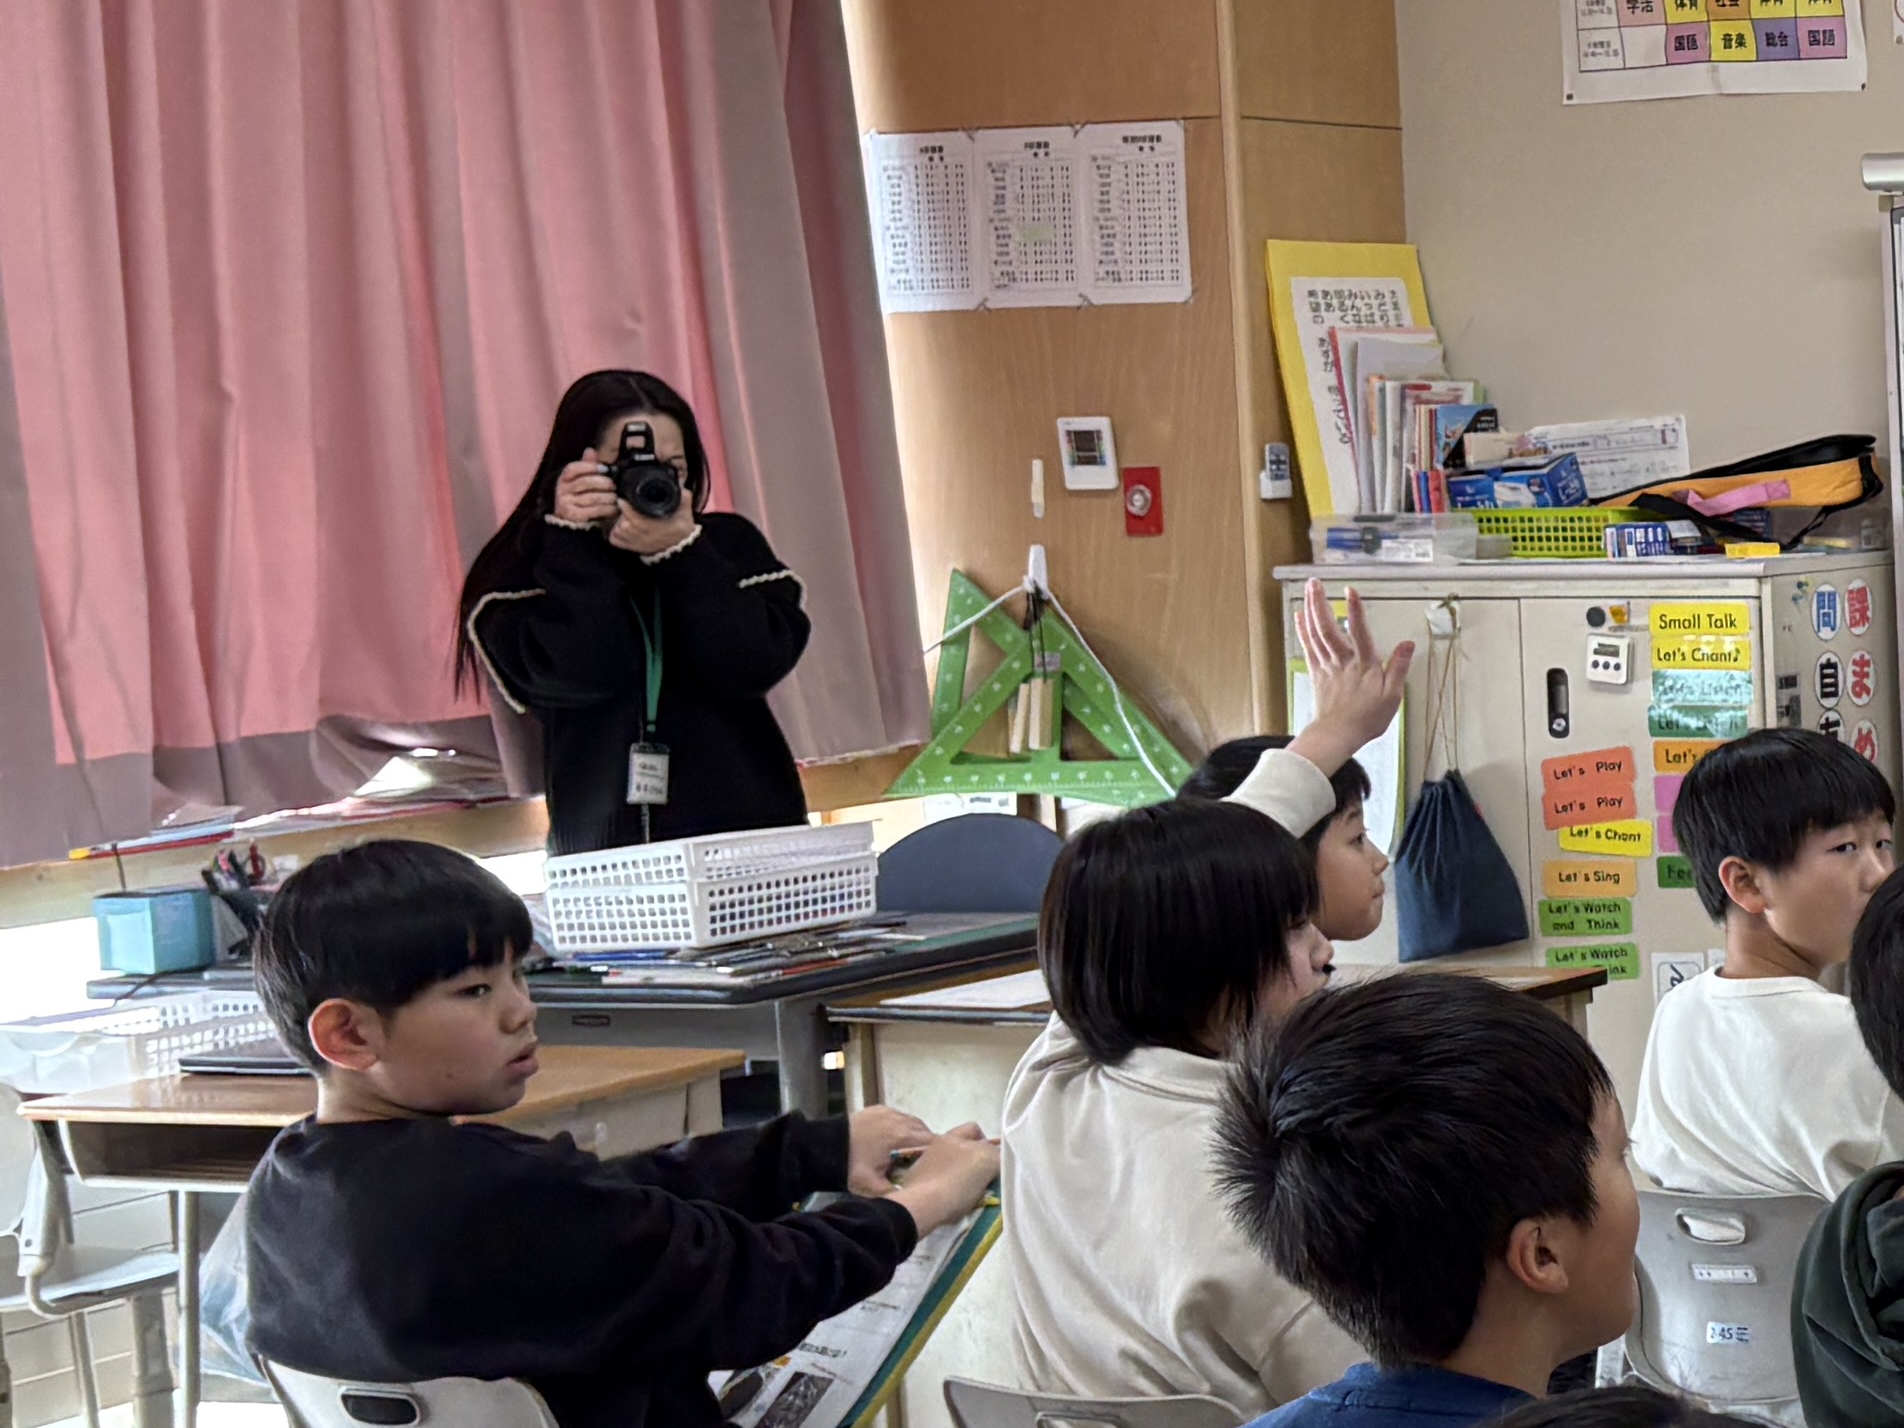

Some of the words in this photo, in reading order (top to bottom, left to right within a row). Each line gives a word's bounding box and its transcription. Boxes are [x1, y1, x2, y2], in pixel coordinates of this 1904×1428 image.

[1816, 590, 1840, 633] 問
[1659, 613, 1701, 630] Small
[1706, 613, 1737, 630] Talk
[1656, 647, 1686, 662] Let's
[1819, 657, 1840, 699] 自
[1851, 653, 1872, 700] ま
[1553, 766, 1586, 781] Let's
[1596, 761, 1623, 772] Play
[1554, 800, 1586, 814] Let's
[1596, 796, 1623, 808] Play
[1569, 826, 1602, 839] Let's
[1605, 827, 1641, 843] Chant
[1558, 871, 1590, 883] Let's
[1593, 870, 1620, 885] Sing
[1548, 902, 1580, 914] Let's
[1583, 901, 1621, 914] Watch
[1552, 920, 1575, 931] and
[1586, 918, 1620, 931] Think
[1554, 950, 1587, 963] Let's
